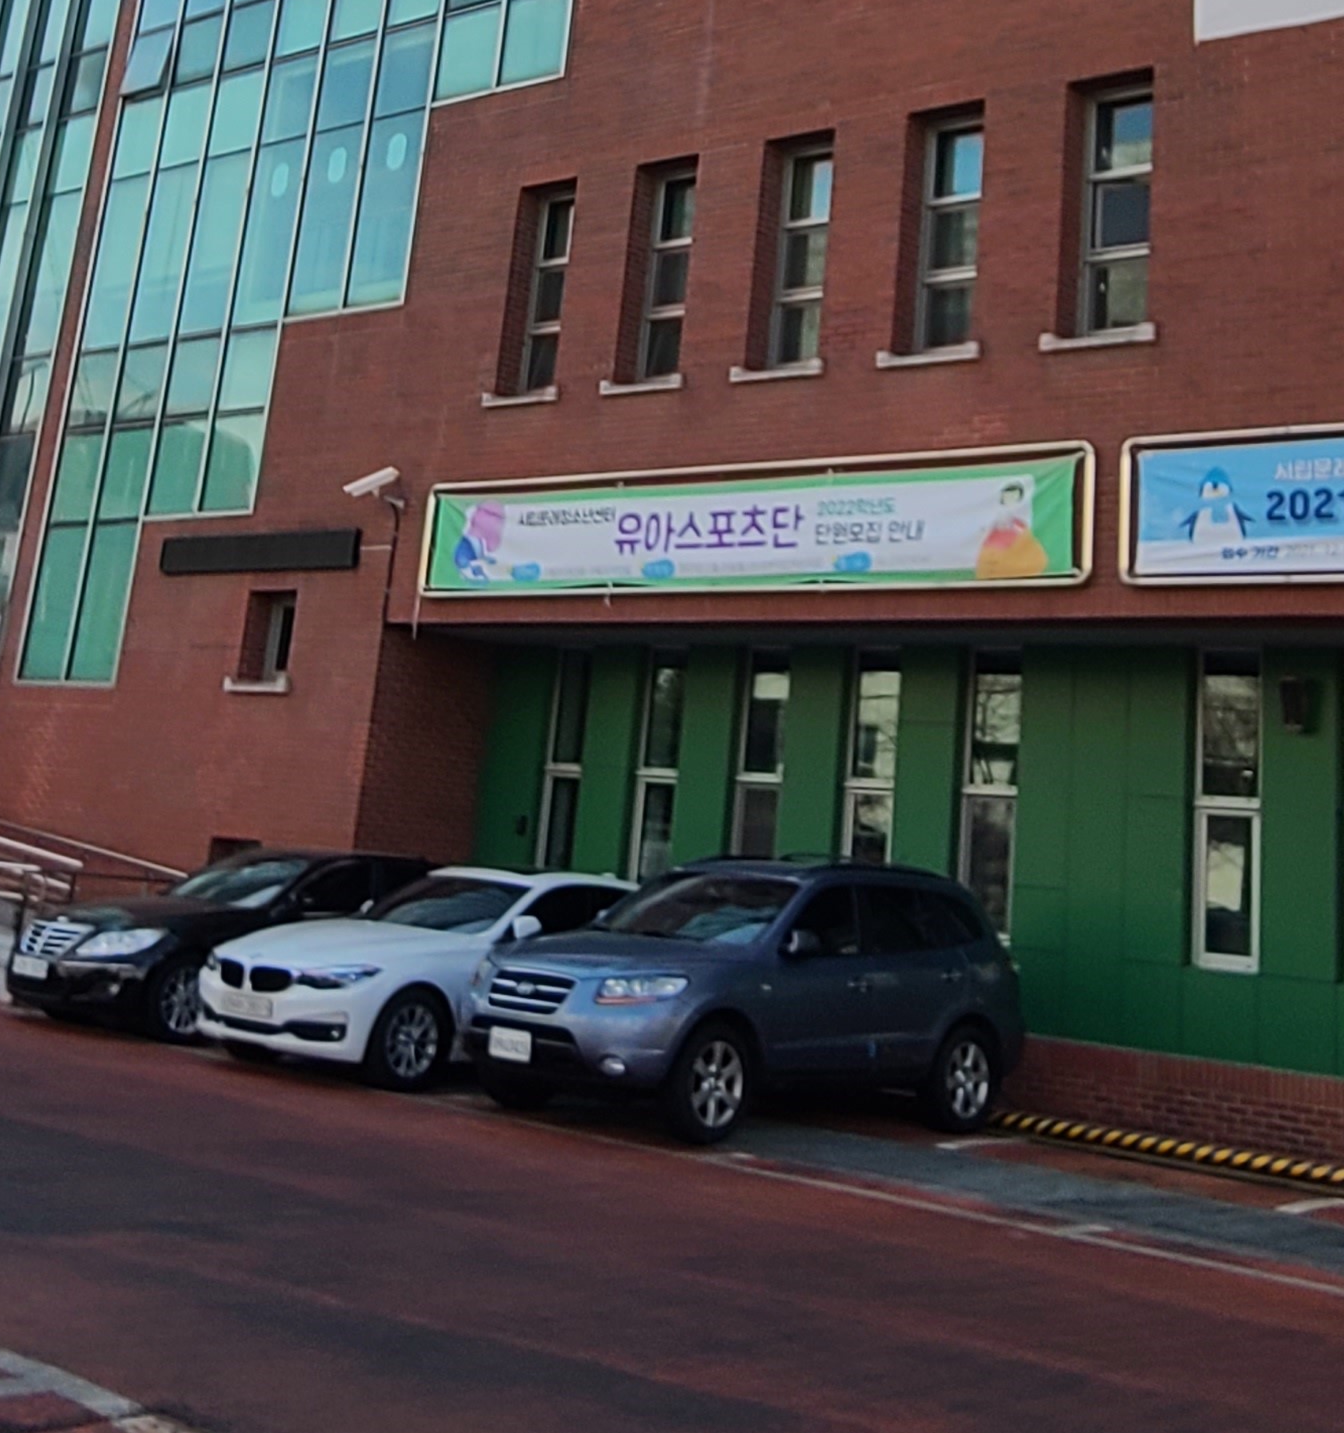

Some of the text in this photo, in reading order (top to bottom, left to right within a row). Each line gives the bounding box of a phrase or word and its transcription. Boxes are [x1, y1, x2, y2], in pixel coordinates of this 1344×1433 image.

[613, 503, 805, 557] 유아스포츠단
[815, 519, 925, 546] 단원모집 안내
